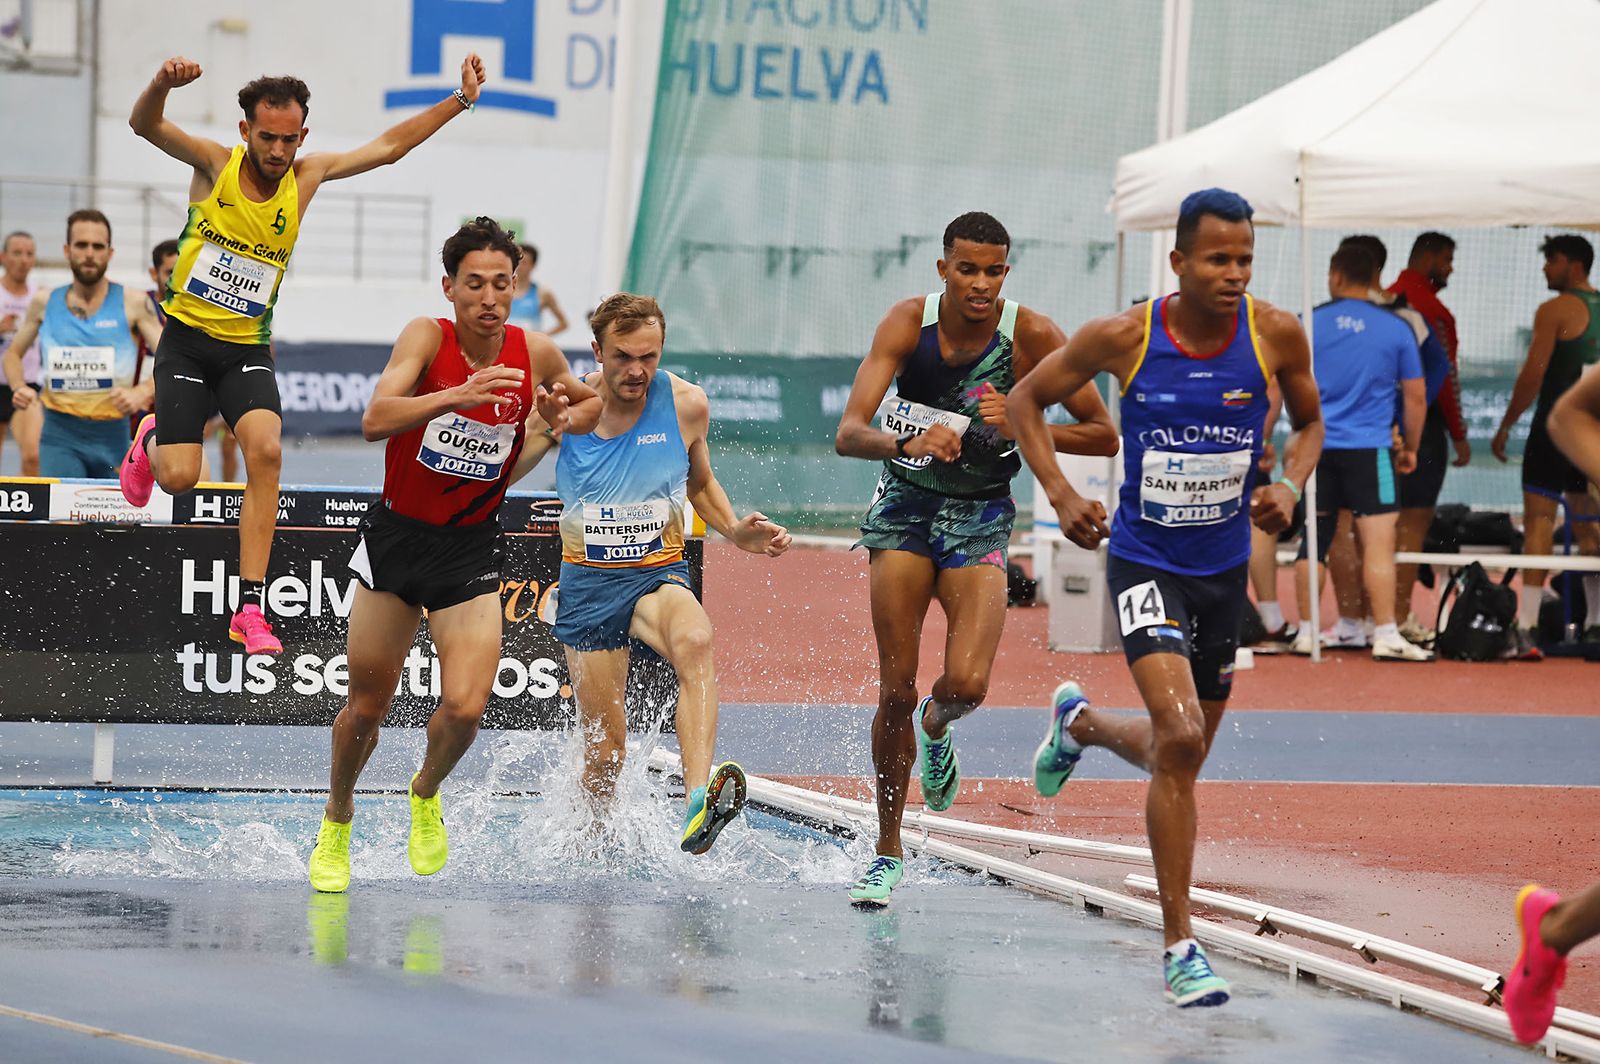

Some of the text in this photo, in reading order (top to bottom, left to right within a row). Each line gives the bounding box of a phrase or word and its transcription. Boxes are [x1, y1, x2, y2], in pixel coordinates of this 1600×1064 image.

[663, 41, 889, 104] HUELVA
[197, 218, 249, 252] Fiamme
[209, 265, 261, 293] BOUIH
[228, 284, 240, 295] 75
[53, 362, 107, 371] MARTOS
[438, 430, 499, 455] OUGRA
[636, 432, 667, 446] HOKA
[1139, 424, 1254, 450] COLOMBIA
[462, 449, 477, 460] 73
[435, 455, 487, 477] Joma
[1144, 474, 1242, 492] SAN MARTIN
[325, 498, 369, 511] Huelva
[1190, 494, 1205, 504] 71
[70, 510, 152, 525] Huelva 2023
[325, 514, 345, 525] tus
[627, 509, 653, 517] HUELVA
[1162, 506, 1221, 523] Joma
[622, 535, 636, 544] 72
[181, 559, 361, 618] Huelv
[1123, 587, 1161, 626] 14
[177, 642, 573, 699] tus setios.
